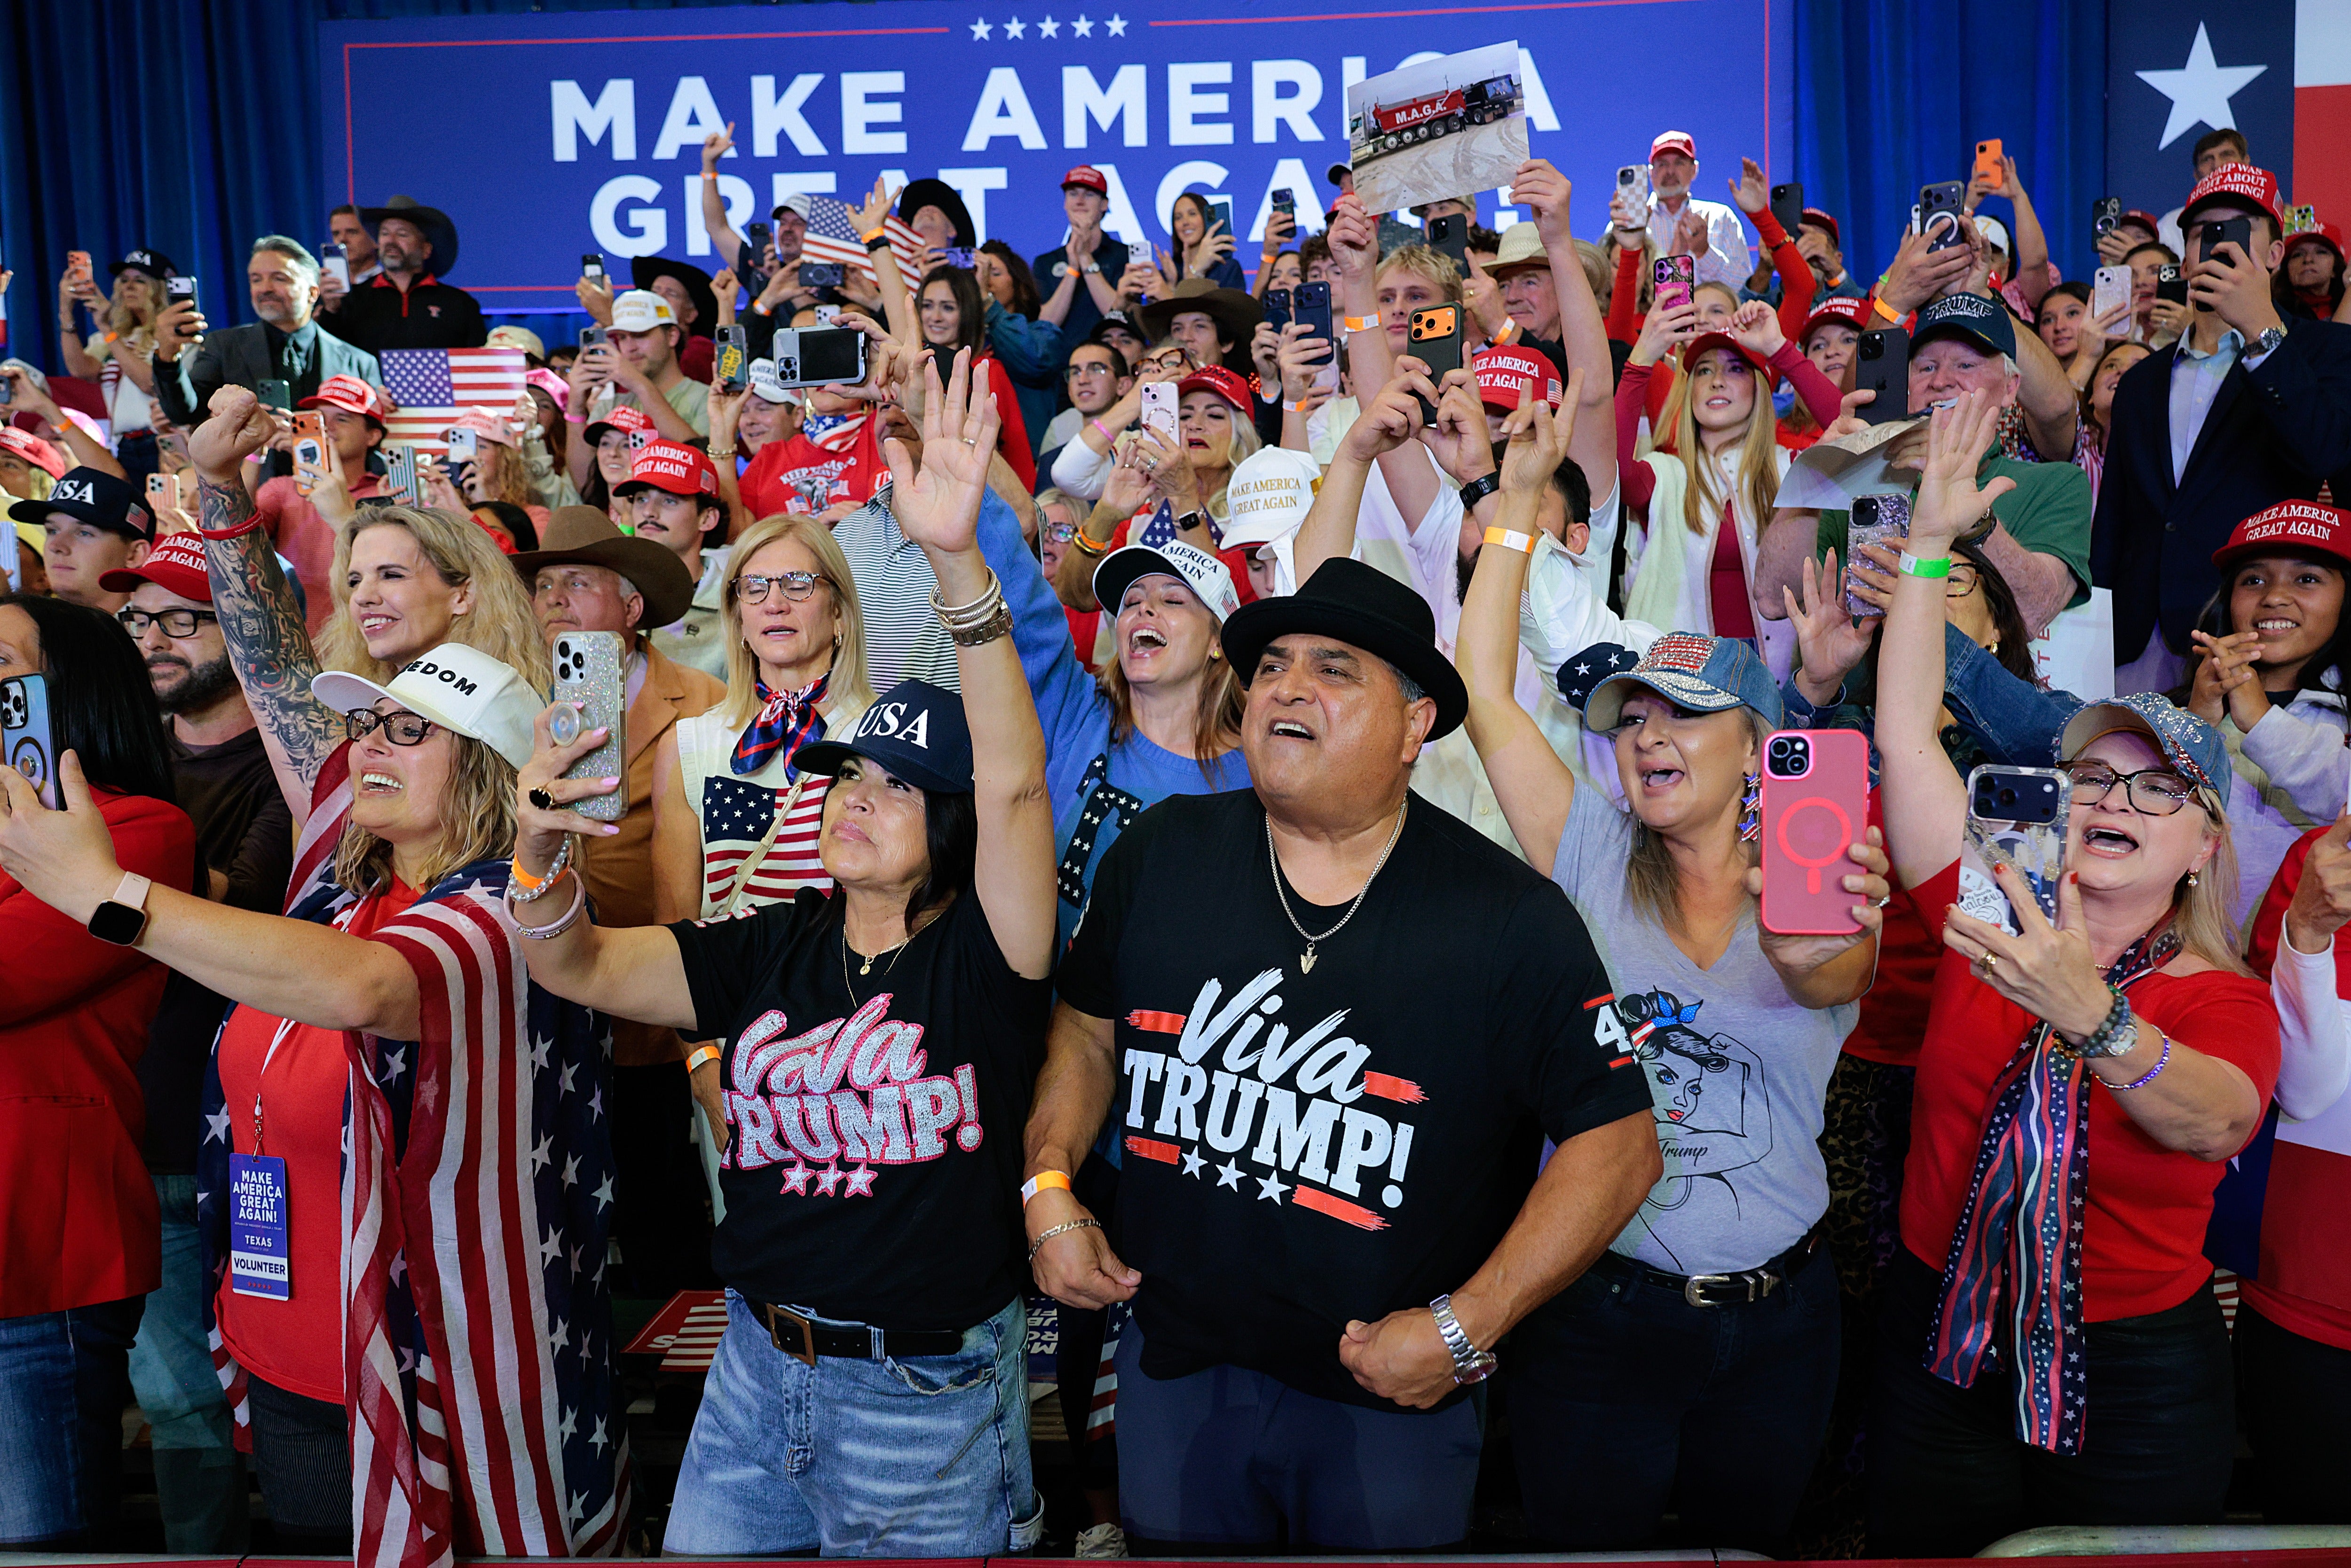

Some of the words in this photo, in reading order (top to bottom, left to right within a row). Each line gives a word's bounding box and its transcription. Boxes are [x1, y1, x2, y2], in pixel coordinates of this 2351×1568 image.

[550, 71, 907, 162] MAKE
[962, 47, 1561, 151] AMERIA
[1395, 104, 1447, 124] M.A.G.A.
[2237, 163, 2262, 175] WAS
[2223, 173, 2267, 187] ABOUT
[1473, 358, 1489, 371] AKE
[1489, 356, 1539, 378] AMERICA
[1492, 374, 1525, 390] AGAI
[649, 445, 694, 465] AMERICA
[653, 460, 687, 479] AGAIN
[47, 480, 95, 505] USA
[1231, 482, 1251, 499] MAKE
[1253, 478, 1301, 493] AMERICA
[1234, 498, 1261, 516] GREAT
[1262, 495, 1297, 510] AGAIN
[2244, 507, 2279, 529] MAKE
[2277, 504, 2340, 527] AMERICA
[2246, 522, 2286, 541] GREAT
[2287, 521, 2331, 541] AGAIN
[168, 536, 205, 555] AMER
[858, 702, 929, 749] USA
[1178, 968, 1371, 1103] Viva
[1124, 1048, 1414, 1209] TRUMP!
[242, 1170, 272, 1185] MAKE
[232, 1182, 283, 1199] AMERICA
[239, 1195, 276, 1210] GREAT
[238, 1207, 277, 1223] AGAIN!
[245, 1235, 272, 1247] TEXAS
[234, 1257, 286, 1276] VOLUNTEER
